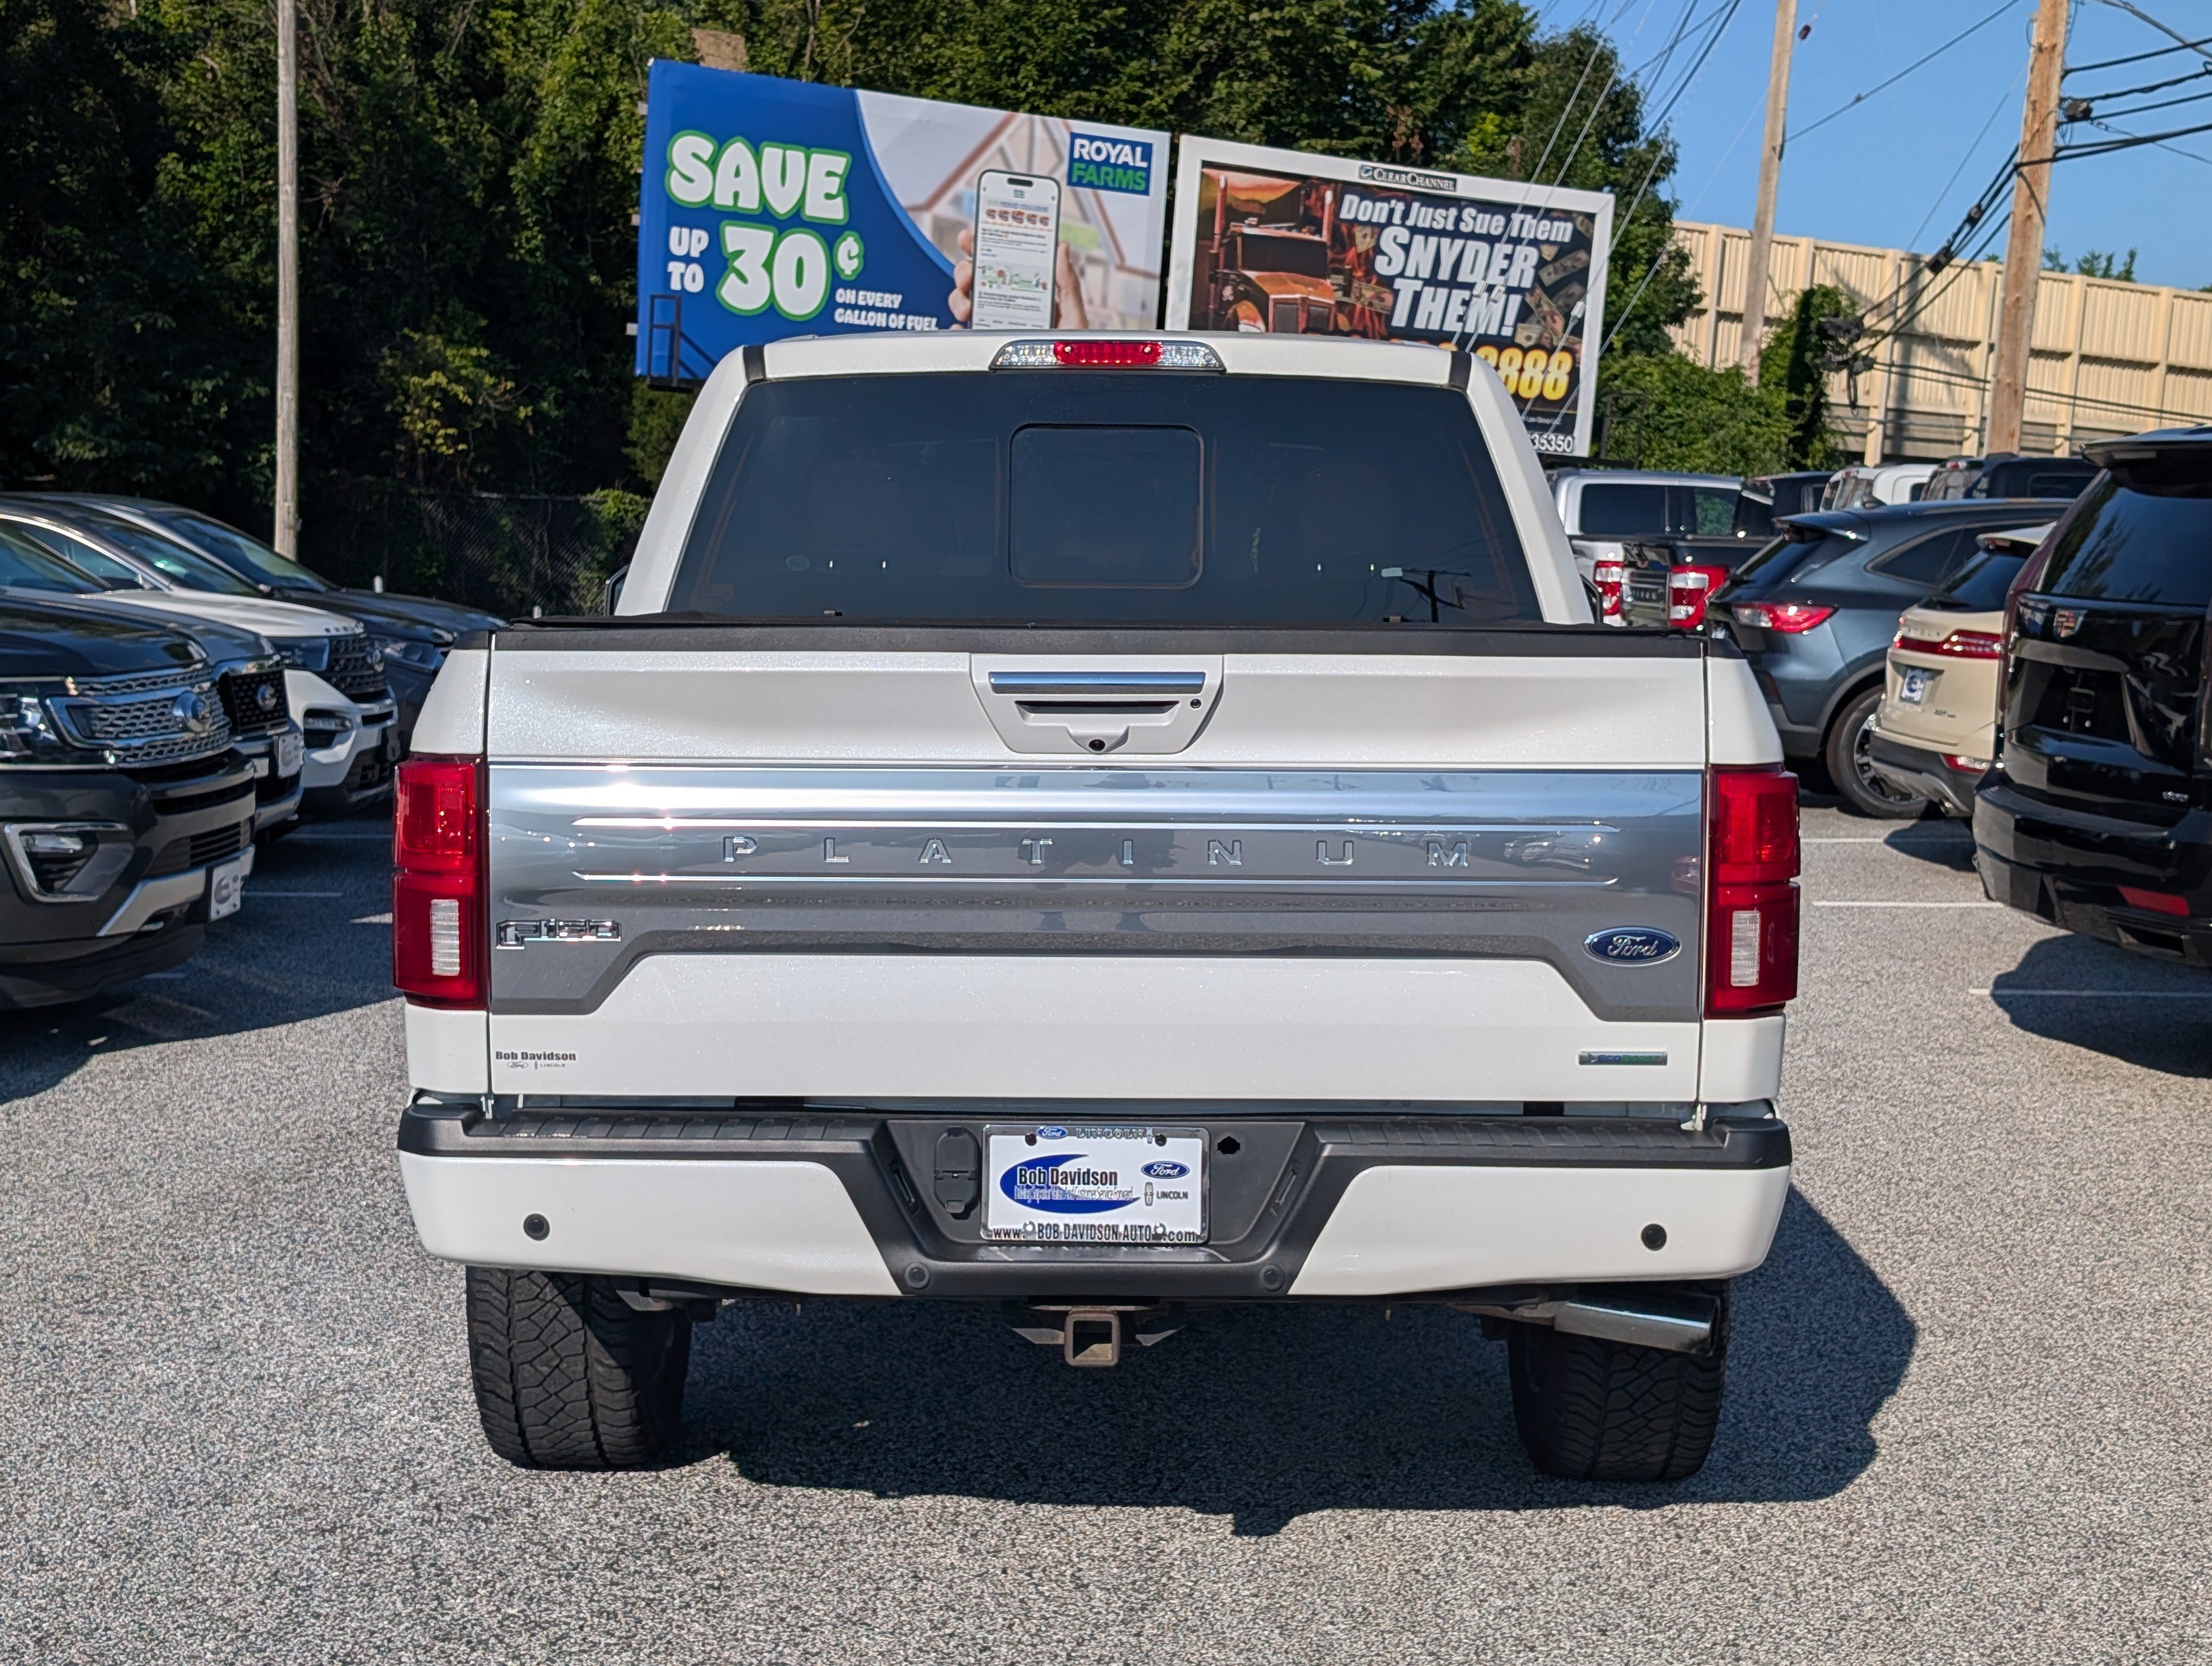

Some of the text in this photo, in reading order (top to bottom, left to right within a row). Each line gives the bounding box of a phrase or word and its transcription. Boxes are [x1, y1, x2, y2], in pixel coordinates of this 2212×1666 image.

[1073, 138, 1148, 168] ROYAL
[670, 134, 848, 220] SAVE
[1071, 162, 1147, 190] FARMS
[1373, 168, 1455, 190] CLEAR CHANNEL
[1339, 195, 1573, 242] Don't Just Sue Them
[668, 226, 709, 258] UP
[1374, 226, 1539, 289] SNYDER
[667, 261, 704, 293] TO
[835, 287, 903, 309] ON EVERY
[1391, 278, 1522, 337] THEM!
[834, 307, 938, 331] GALLON OF FUEL
[722, 836, 1469, 867] PLATINUM
[496, 1051, 576, 1061] Bob Davidson
[1075, 1128, 1144, 1139] LINCOLN
[1019, 1168, 1118, 1186] Bob Davidson
[1156, 1190, 1188, 1200] LINCOLN
[1038, 1225, 1059, 1240] BOB
[1063, 1225, 1118, 1240] DAVIDSON
[1123, 1225, 1152, 1241] AUTO
